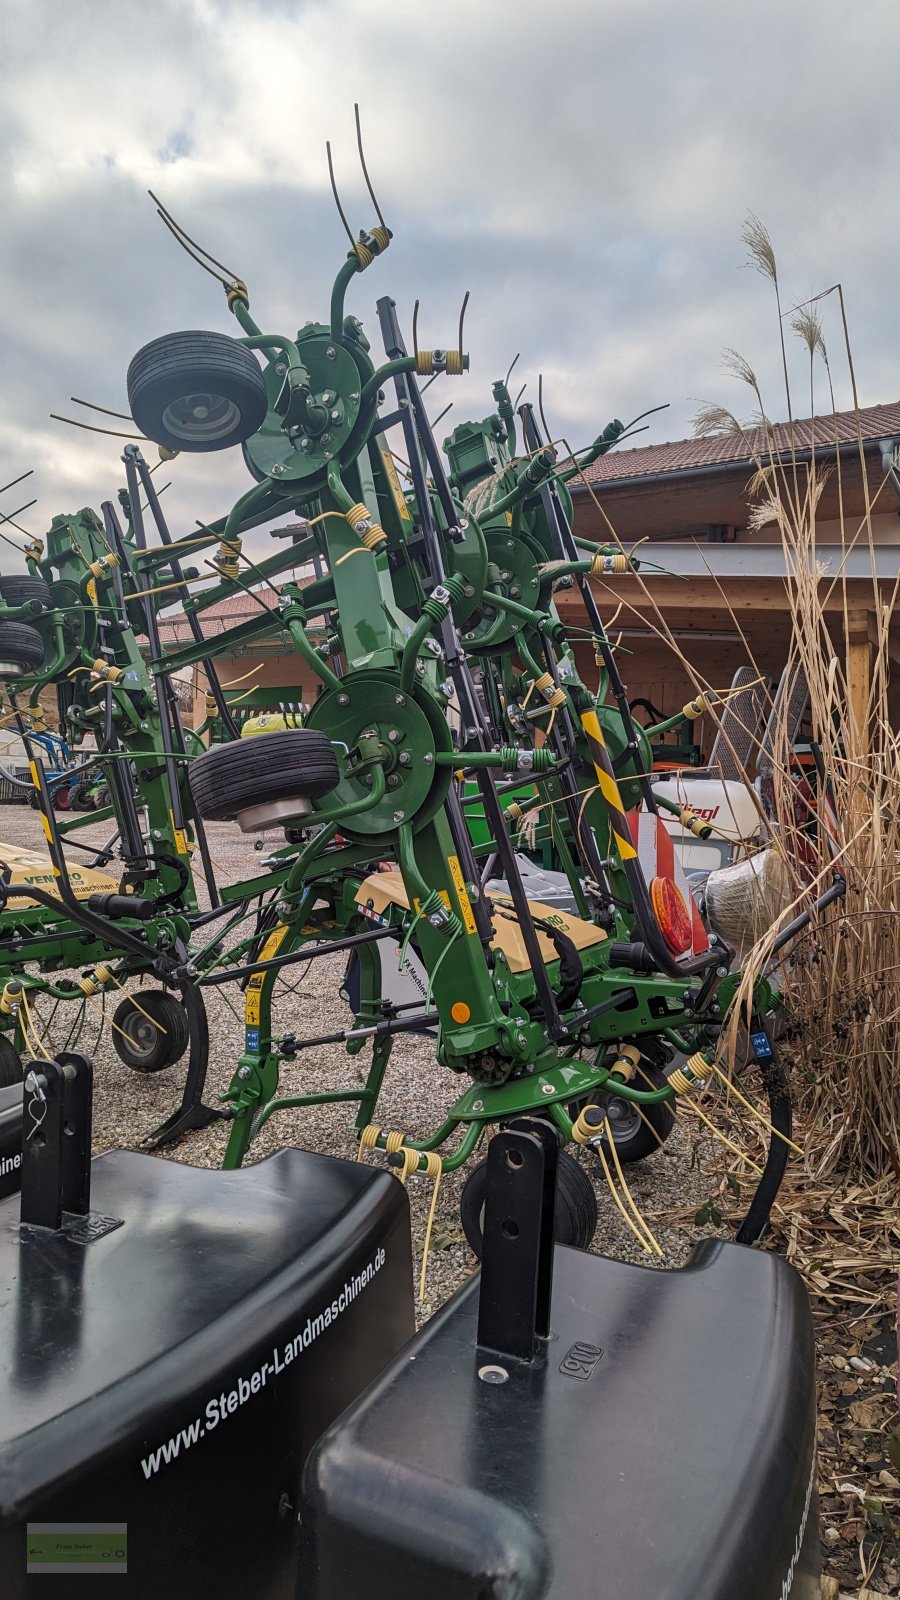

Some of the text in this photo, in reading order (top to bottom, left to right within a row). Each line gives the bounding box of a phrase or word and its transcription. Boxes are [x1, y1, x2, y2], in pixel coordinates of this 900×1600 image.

[24, 873, 81, 885] VENO
[0, 1152, 23, 1176] ine
[141, 1247, 386, 1480] www.Steber-Landmaschinen.de
